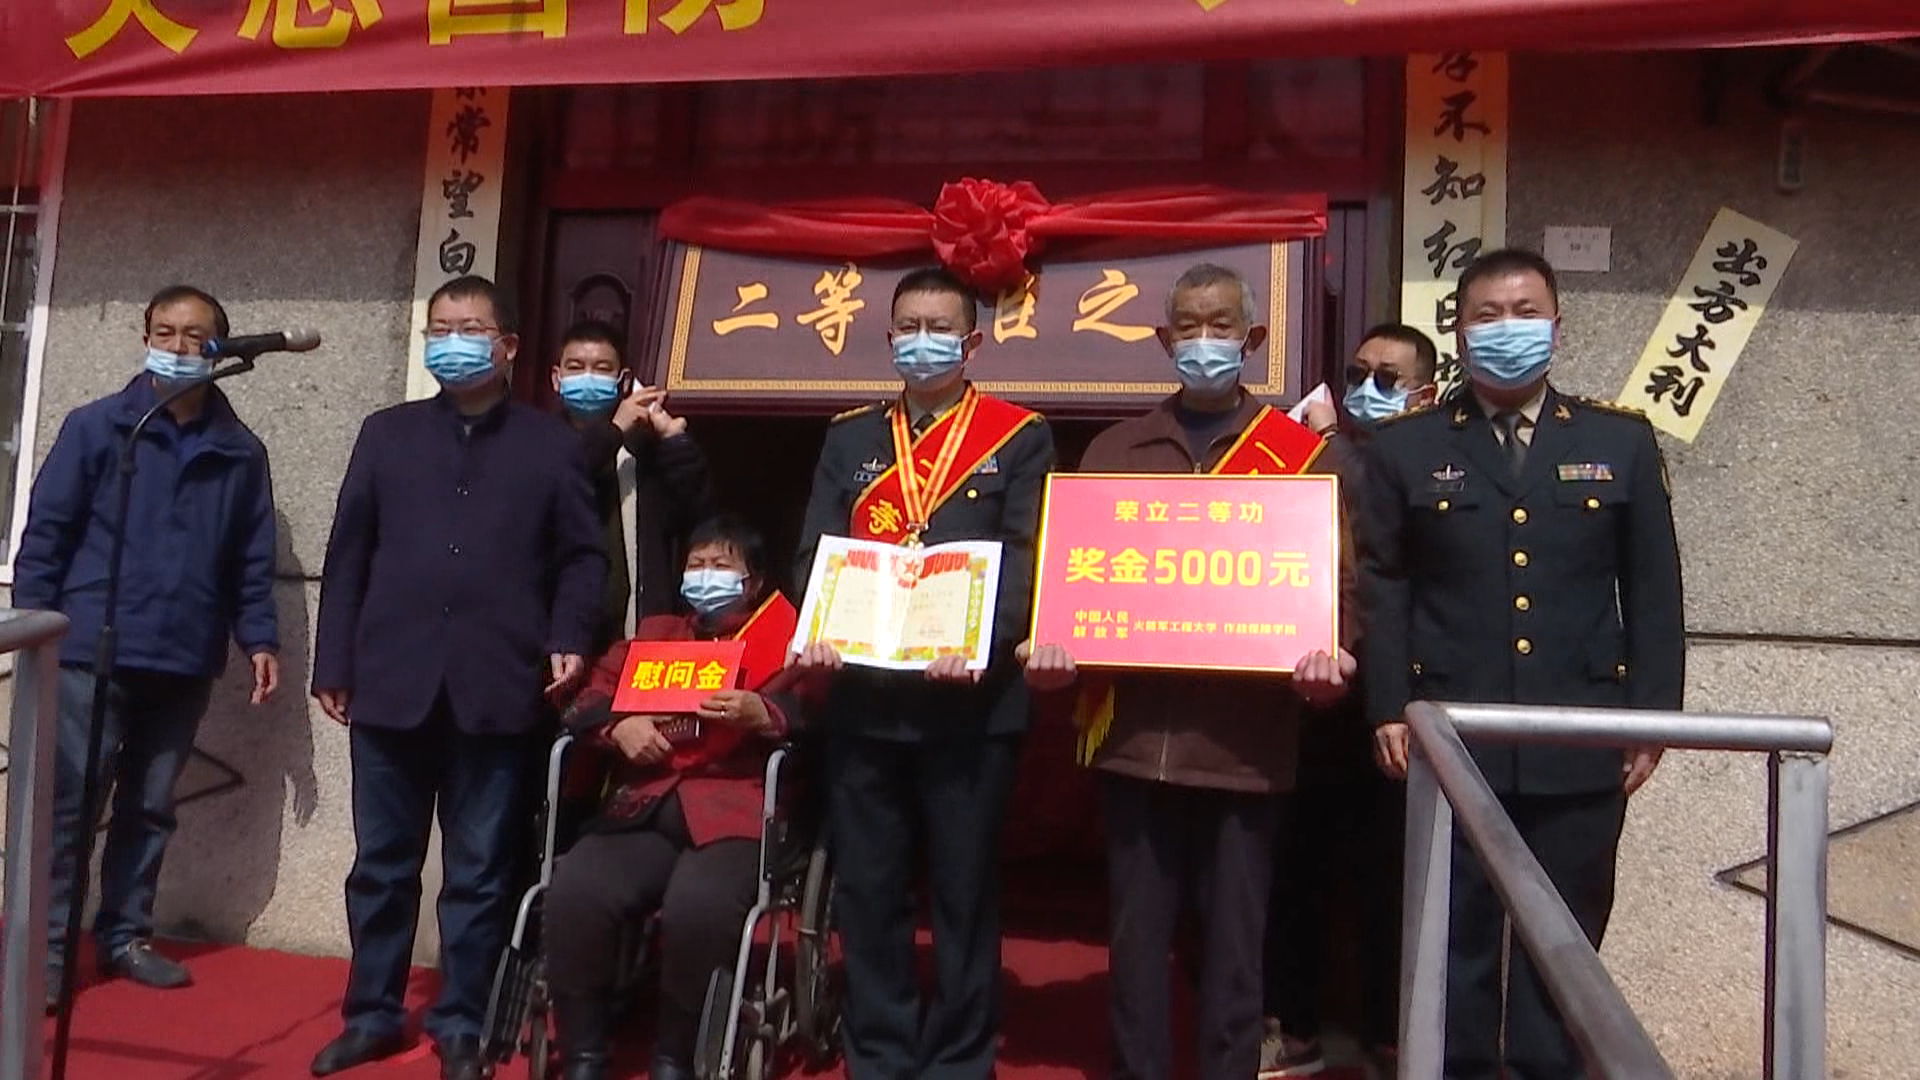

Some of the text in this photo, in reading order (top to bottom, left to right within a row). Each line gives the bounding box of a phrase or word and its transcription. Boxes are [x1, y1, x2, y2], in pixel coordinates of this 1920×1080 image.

[713, 262, 1158, 356] 二等臣之
[1114, 500, 1264, 524] 荣立二等功
[1065, 547, 1311, 587] 奖金5000元
[1074, 609, 1129, 624] 中国人民
[631, 660, 728, 691] 慰问金
